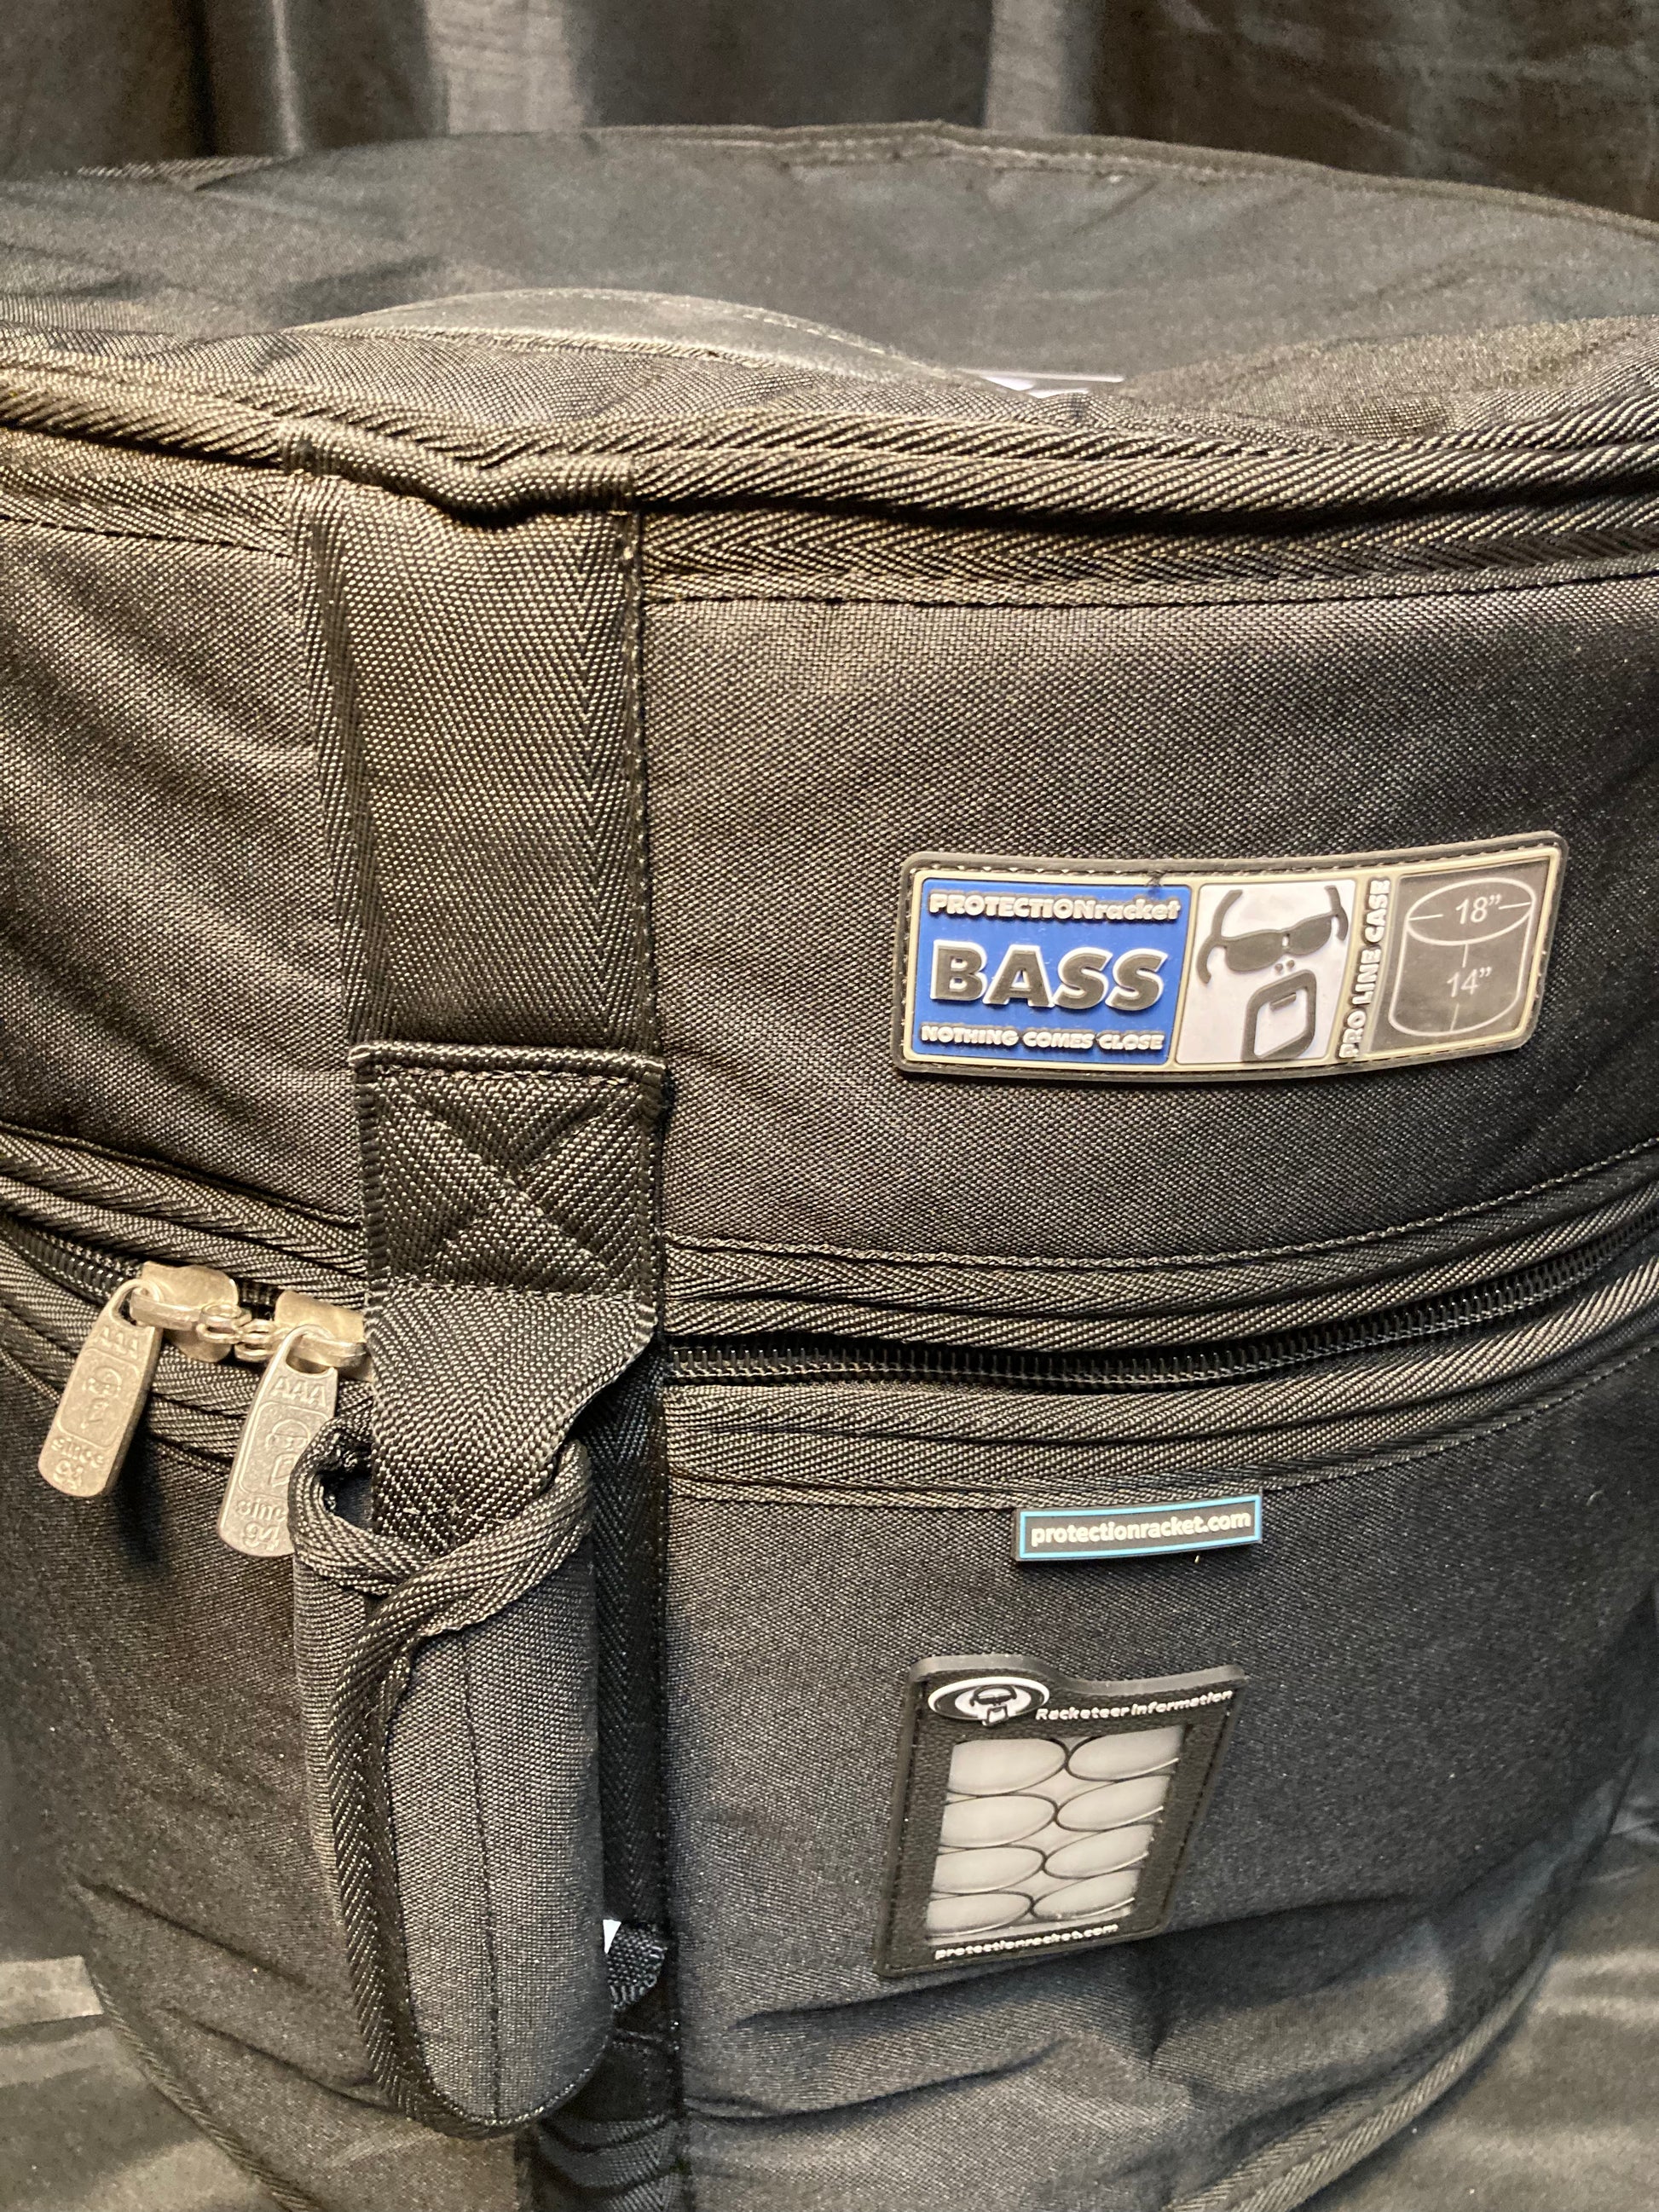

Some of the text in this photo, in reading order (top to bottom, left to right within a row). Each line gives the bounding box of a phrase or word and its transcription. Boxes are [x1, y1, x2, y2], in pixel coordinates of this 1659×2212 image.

[928, 891, 1181, 921] PROTECTIONracket
[929, 939, 1169, 1012] BASS
[1338, 879, 1391, 1059] PRO LINE CASE
[921, 1024, 1165, 1051] NOTHING COMES CLOSE
[50, 1435, 106, 1470] since
[242, 1522, 280, 1552] 94
[1031, 1511, 1251, 1547] protectionracket.com
[1035, 1690, 1234, 1721] Racketeer Information
[934, 1923, 1119, 1961] protectionracket.com
